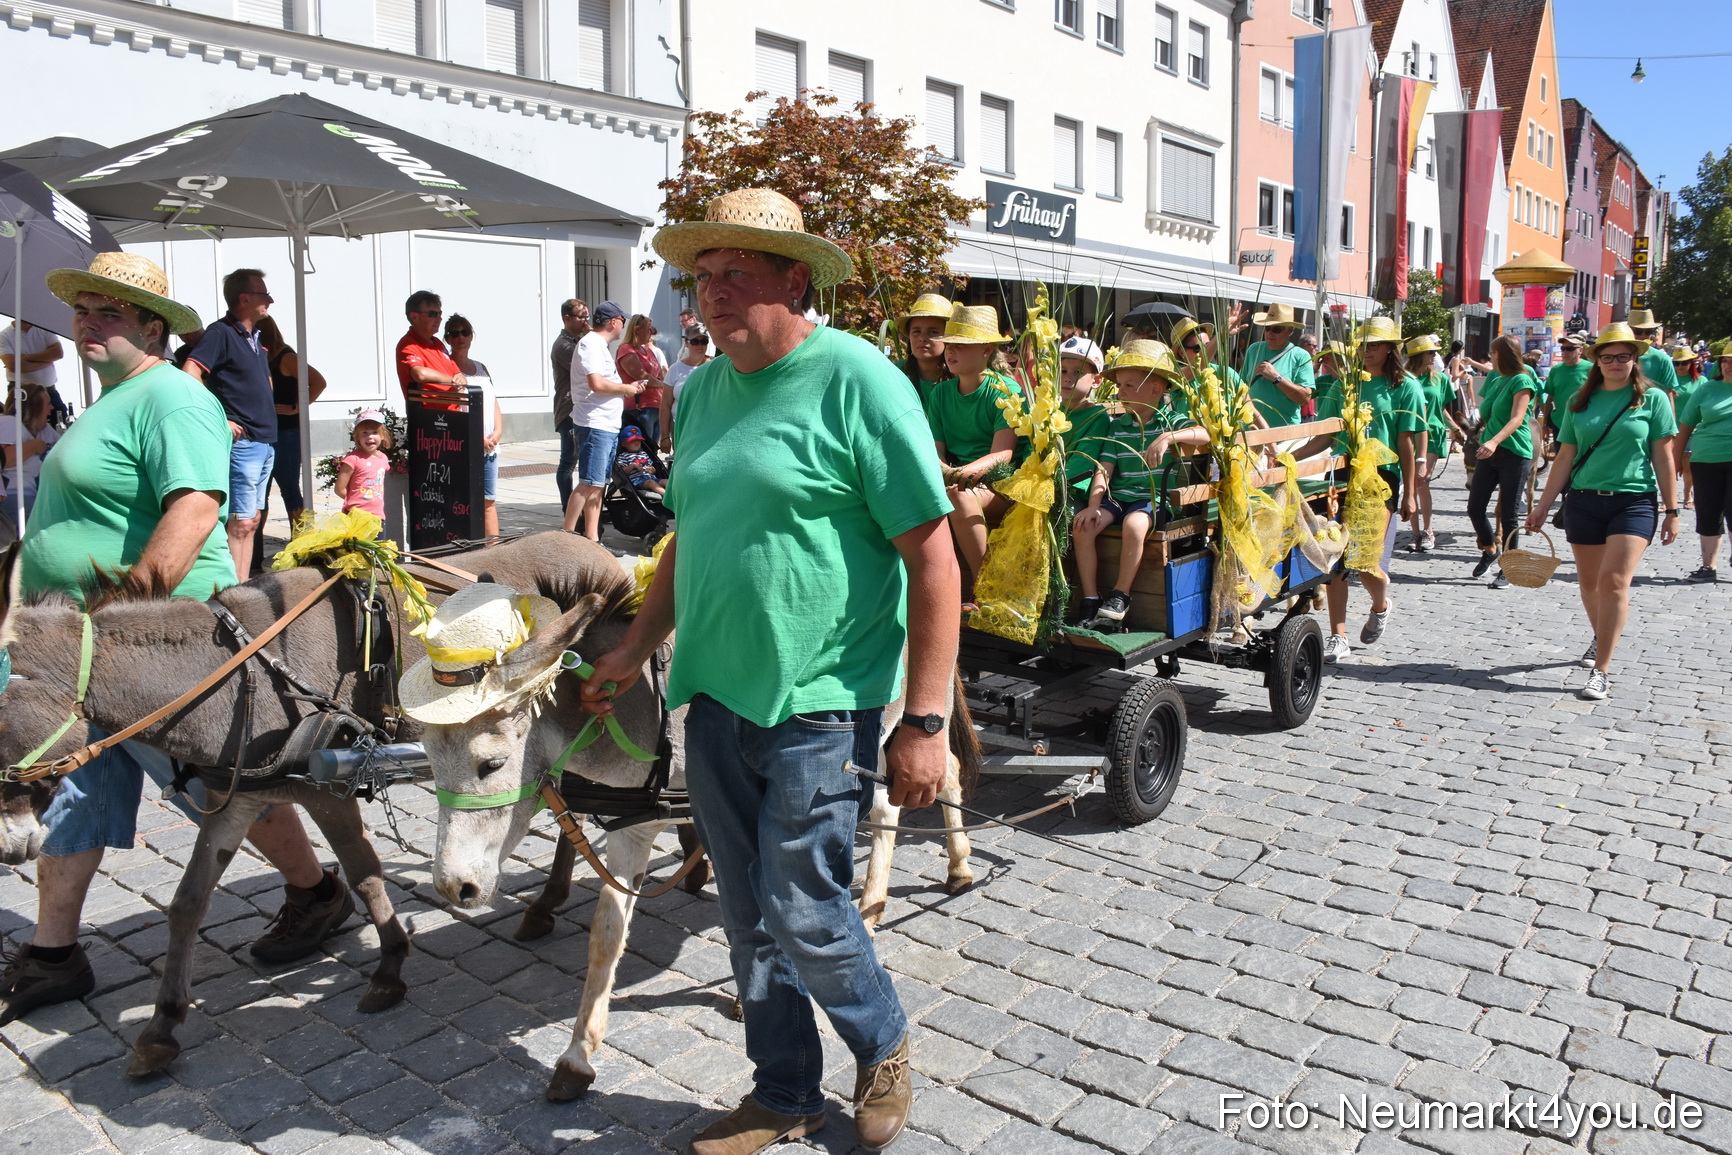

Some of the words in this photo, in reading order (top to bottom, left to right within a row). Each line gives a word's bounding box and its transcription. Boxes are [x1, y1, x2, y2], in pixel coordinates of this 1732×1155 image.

[993, 190, 1075, 238] frühauf
[1632, 238, 1649, 308] HOTEL
[416, 428, 442, 459] Happy
[443, 430, 465, 451] Hour
